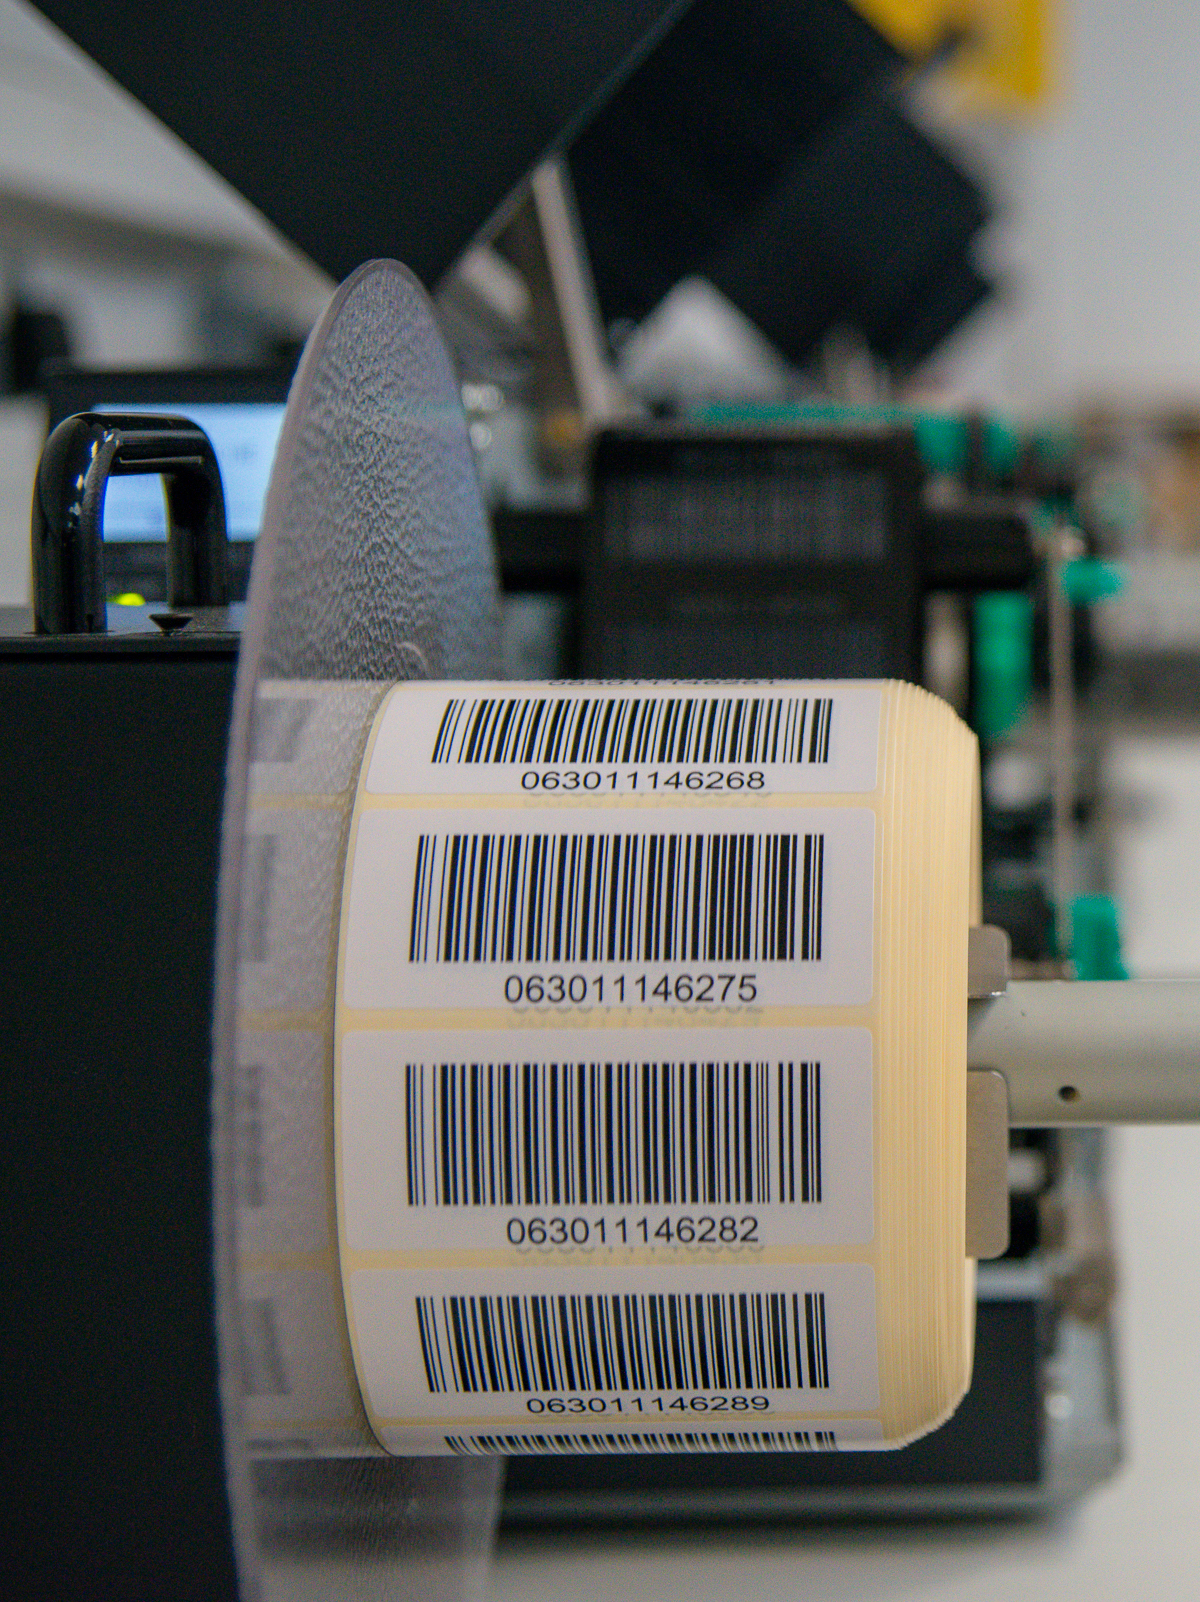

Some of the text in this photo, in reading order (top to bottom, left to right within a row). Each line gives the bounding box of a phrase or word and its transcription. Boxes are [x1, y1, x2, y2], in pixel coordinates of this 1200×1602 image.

[521, 771, 765, 790] 063011146268
[504, 974, 757, 1003] 063011146275
[507, 1216, 759, 1244] 063011146282
[526, 1396, 770, 1414] 063011146289
